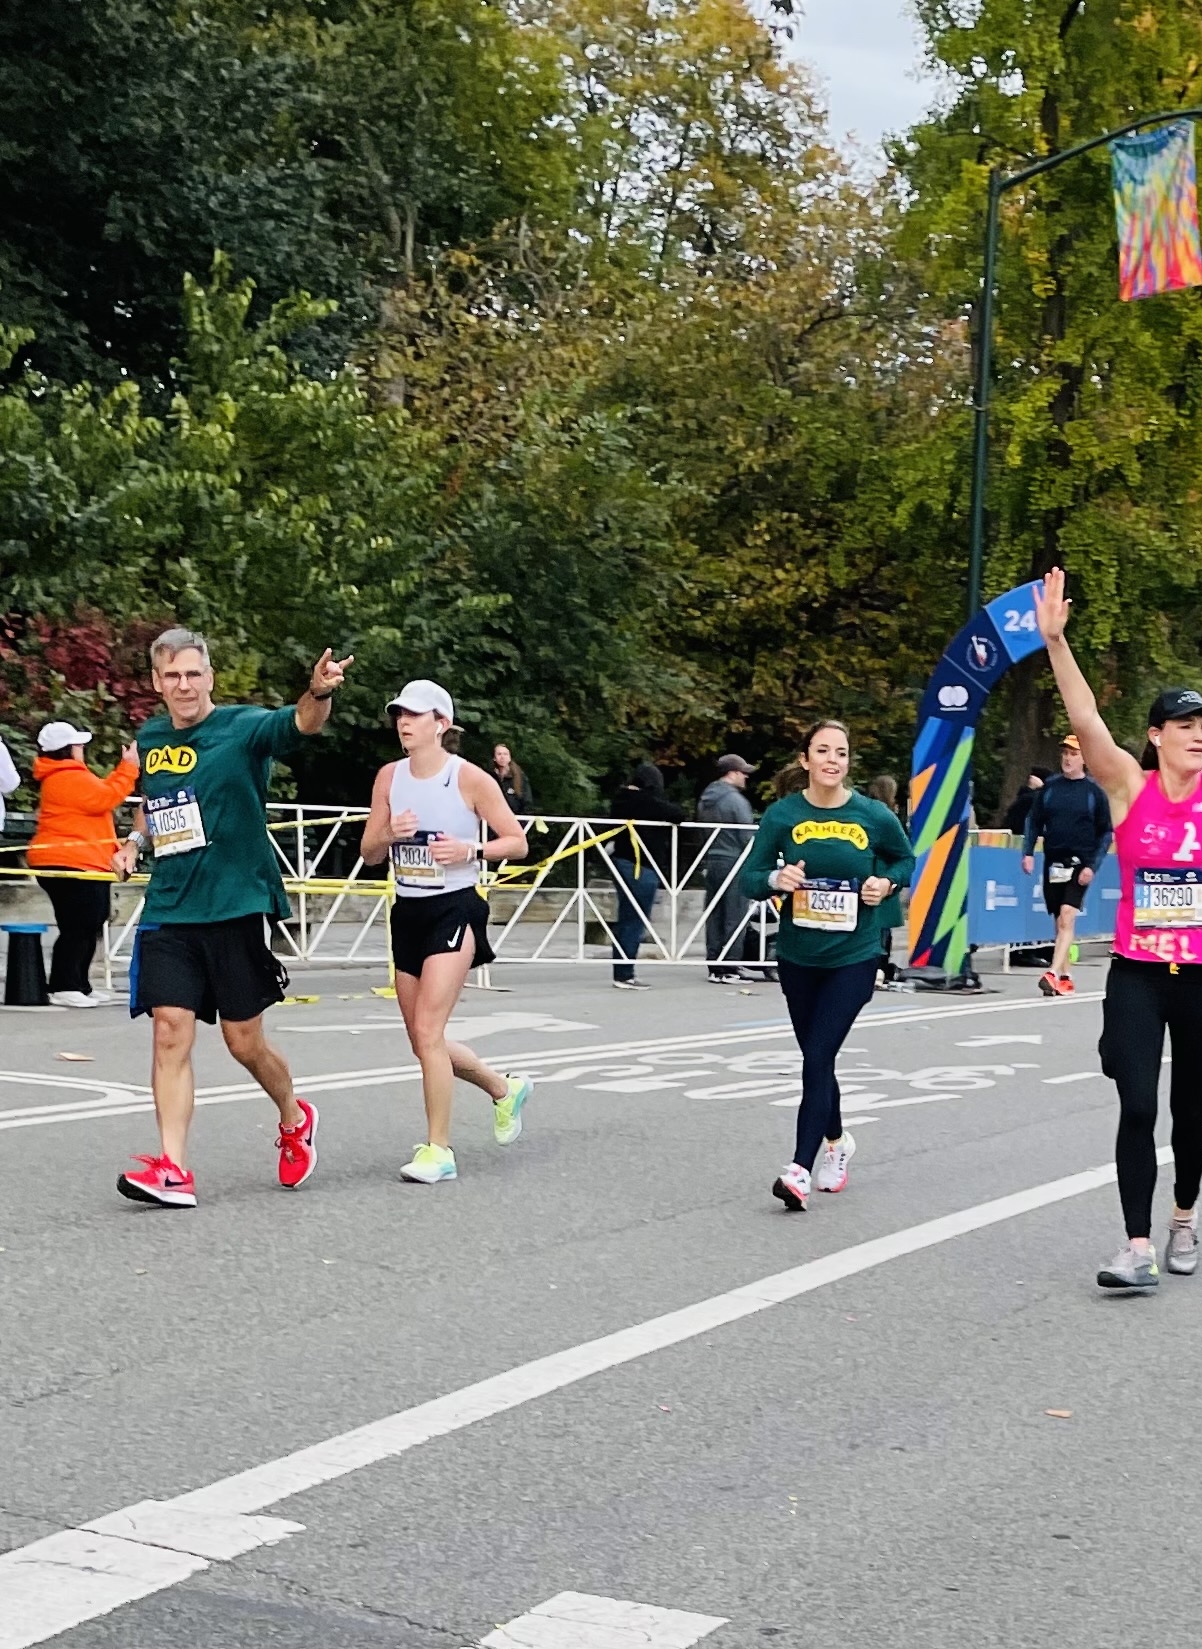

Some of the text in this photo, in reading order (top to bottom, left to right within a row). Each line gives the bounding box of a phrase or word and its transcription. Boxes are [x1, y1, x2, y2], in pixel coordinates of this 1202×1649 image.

[1003, 609, 1037, 632] 24
[149, 749, 192, 769] DAD
[159, 808, 186, 832] 10515
[795, 826, 865, 844] KATHLEEN
[401, 845, 434, 867] 30340
[811, 891, 845, 912] 25544
[1153, 886, 1193, 907] 36290
[1129, 932, 1198, 961] MEL
